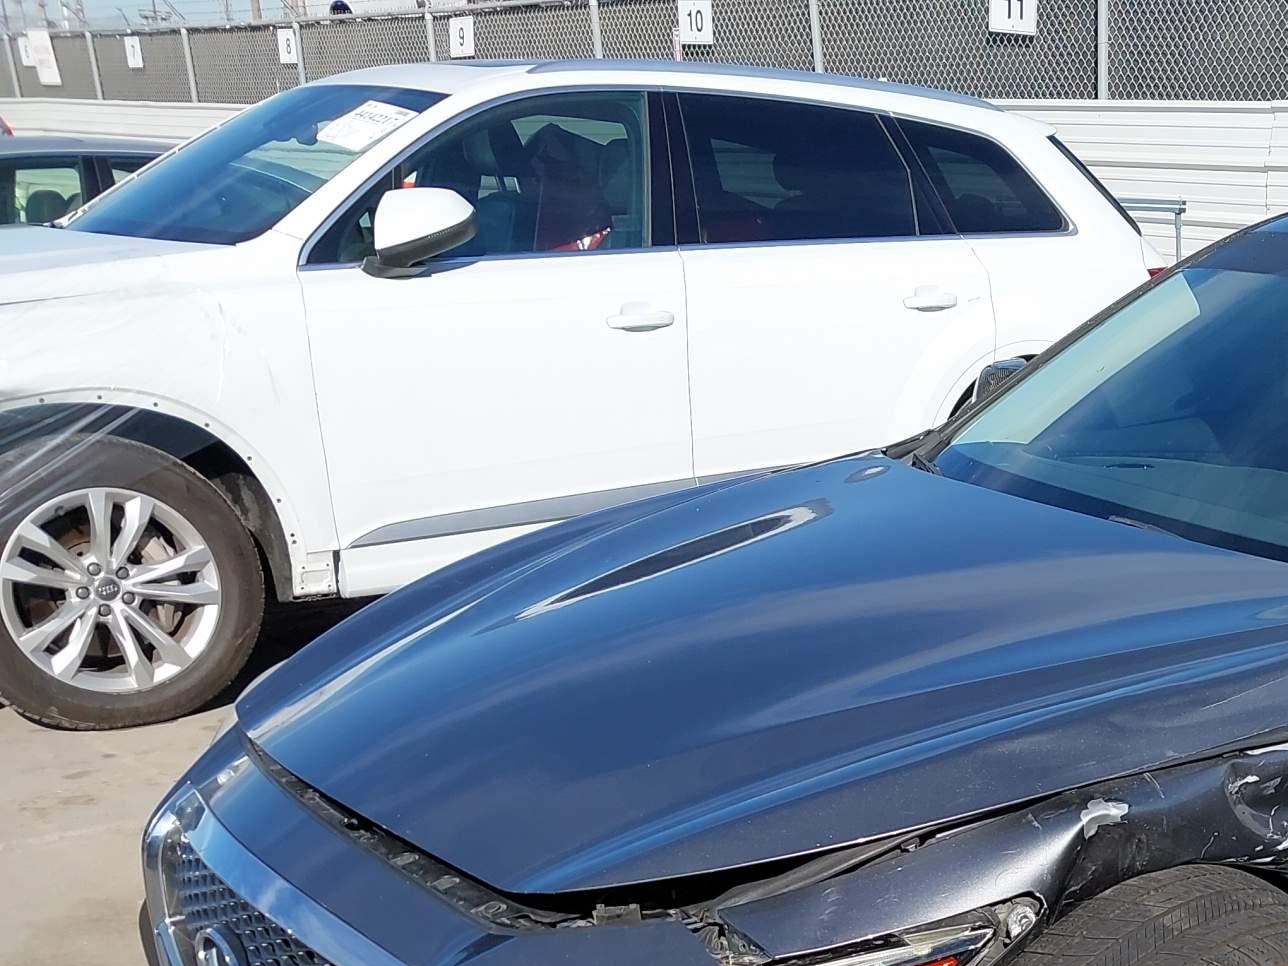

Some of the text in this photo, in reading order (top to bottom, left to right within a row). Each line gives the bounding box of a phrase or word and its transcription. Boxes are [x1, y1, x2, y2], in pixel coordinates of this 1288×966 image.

[1004, 0, 1024, 20] 11
[687, 9, 704, 33] 10
[458, 27, 466, 46] 9
[285, 38, 292, 55] 8
